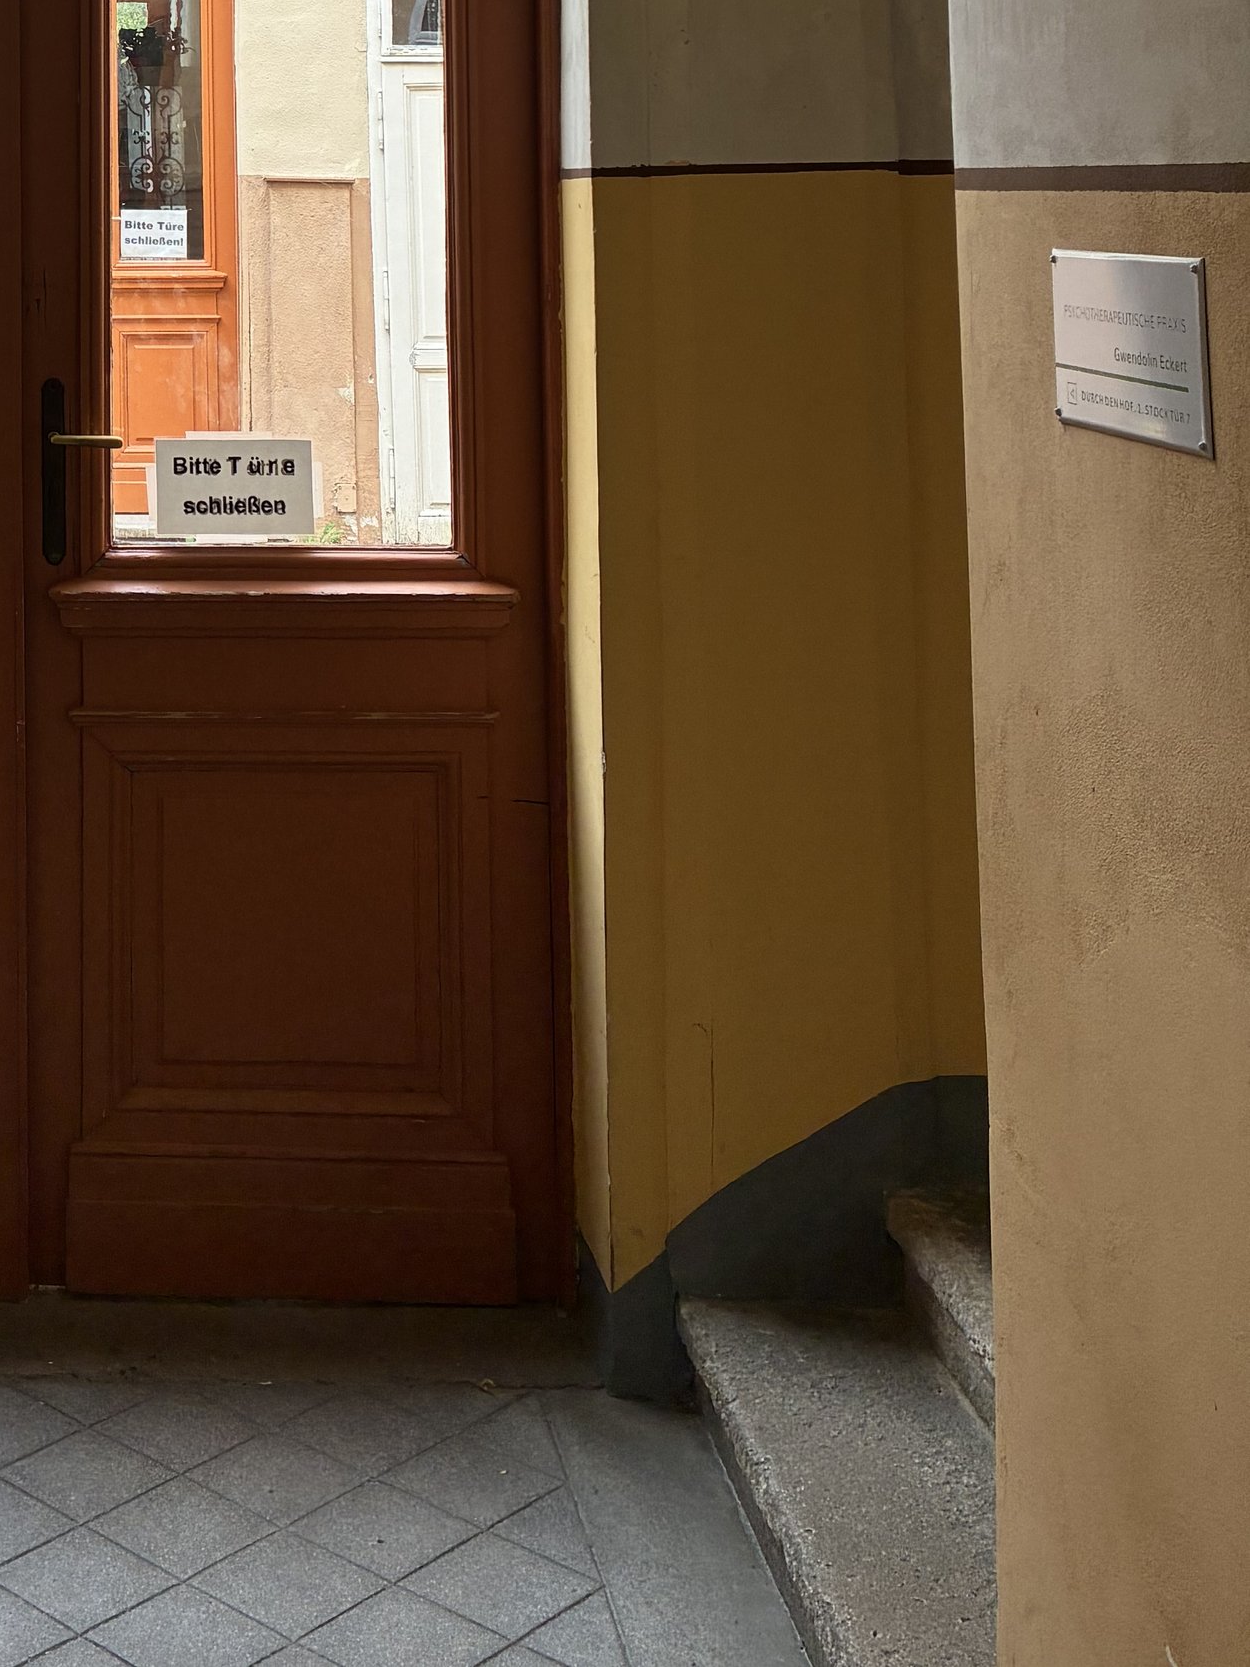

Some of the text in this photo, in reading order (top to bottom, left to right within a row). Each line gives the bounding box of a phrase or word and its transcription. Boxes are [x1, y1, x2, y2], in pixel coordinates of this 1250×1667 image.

[124, 220, 184, 231] Bitte Türe
[124, 236, 184, 246] schließen!
[1064, 304, 1186, 333] PSYCHOTHERAPEUTISCHE PRAXIS
[1114, 347, 1187, 373] Gwendolin Eckert
[1081, 390, 1103, 404] DURCH
[1105, 397, 1118, 409] DEN
[173, 456, 222, 476] Bitte
[183, 495, 286, 515] schließen
